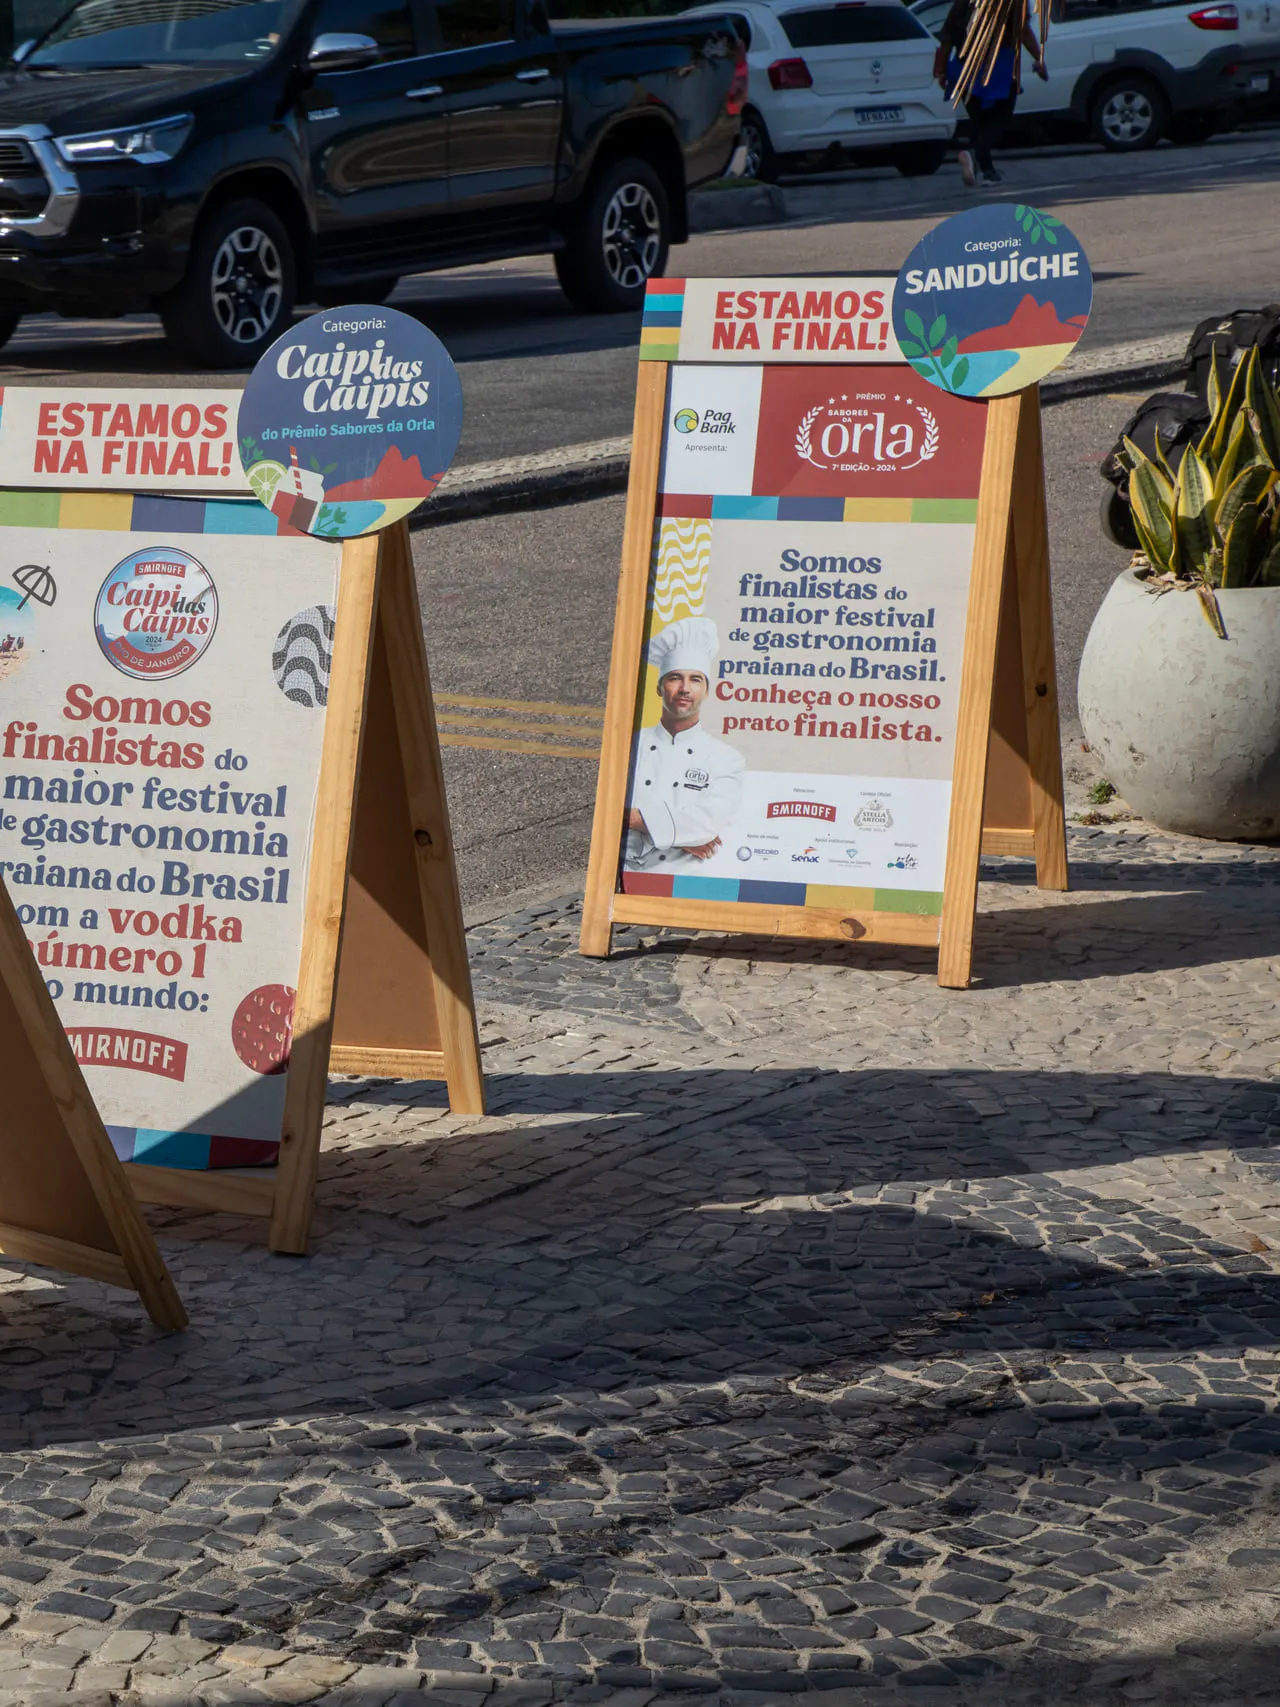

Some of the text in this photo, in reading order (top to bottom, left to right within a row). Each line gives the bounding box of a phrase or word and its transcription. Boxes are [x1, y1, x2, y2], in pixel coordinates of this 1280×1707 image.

[964, 236, 1022, 254] Categoria:
[904, 251, 1080, 295] SANDUÍCHE
[715, 290, 885, 320] ESTAMOS
[322, 318, 387, 334] Categoria:
[712, 322, 889, 351] NA FINAL!
[276, 339, 423, 385] Caipi das
[303, 375, 430, 419] Caipis
[856, 392, 886, 401] PRÊMIO
[37, 402, 228, 438] ESTAMOS
[261, 418, 435, 440] do Prêmio Sabores da Orla
[700, 421, 737, 434] Bank
[704, 409, 733, 424] Pag
[685, 443, 728, 453] Apresenta:
[821, 411, 914, 461] orla
[33, 440, 233, 477] NA FINAL!
[840, 462, 870, 472] EDIÇÃO
[876, 464, 897, 472] 2024
[138, 563, 182, 575] SMIRNOFF
[779, 548, 882, 575] Somos
[106, 581, 206, 615] Caipi das
[738, 573, 908, 601] finalistas do
[123, 608, 210, 641] Caipis
[740, 601, 935, 629] maior festival
[115, 641, 191, 668] RIO DE JANEIRO
[729, 627, 937, 654] de gastronomia
[717, 656, 947, 682] praiana do Brasil.
[62, 683, 212, 728] Somos
[715, 680, 941, 712] Conheça o nosso
[722, 713, 943, 743] prato finalista.
[2, 721, 248, 771] finalistas do
[3, 768, 288, 818] maior festival
[772, 804, 832, 819] SMIRNOFF
[861, 816, 887, 824] ARTOIS
[21, 813, 289, 858] gastronomia
[754, 848, 779, 856] RECORD
[116, 866, 156, 893] do
[160, 860, 290, 904] Brasil
[16, 903, 244, 943] om a vodka
[28, 930, 207, 979] úmero 1
[43, 974, 210, 1013] o mundo:
[67, 1033, 176, 1069] MIRNOFF
